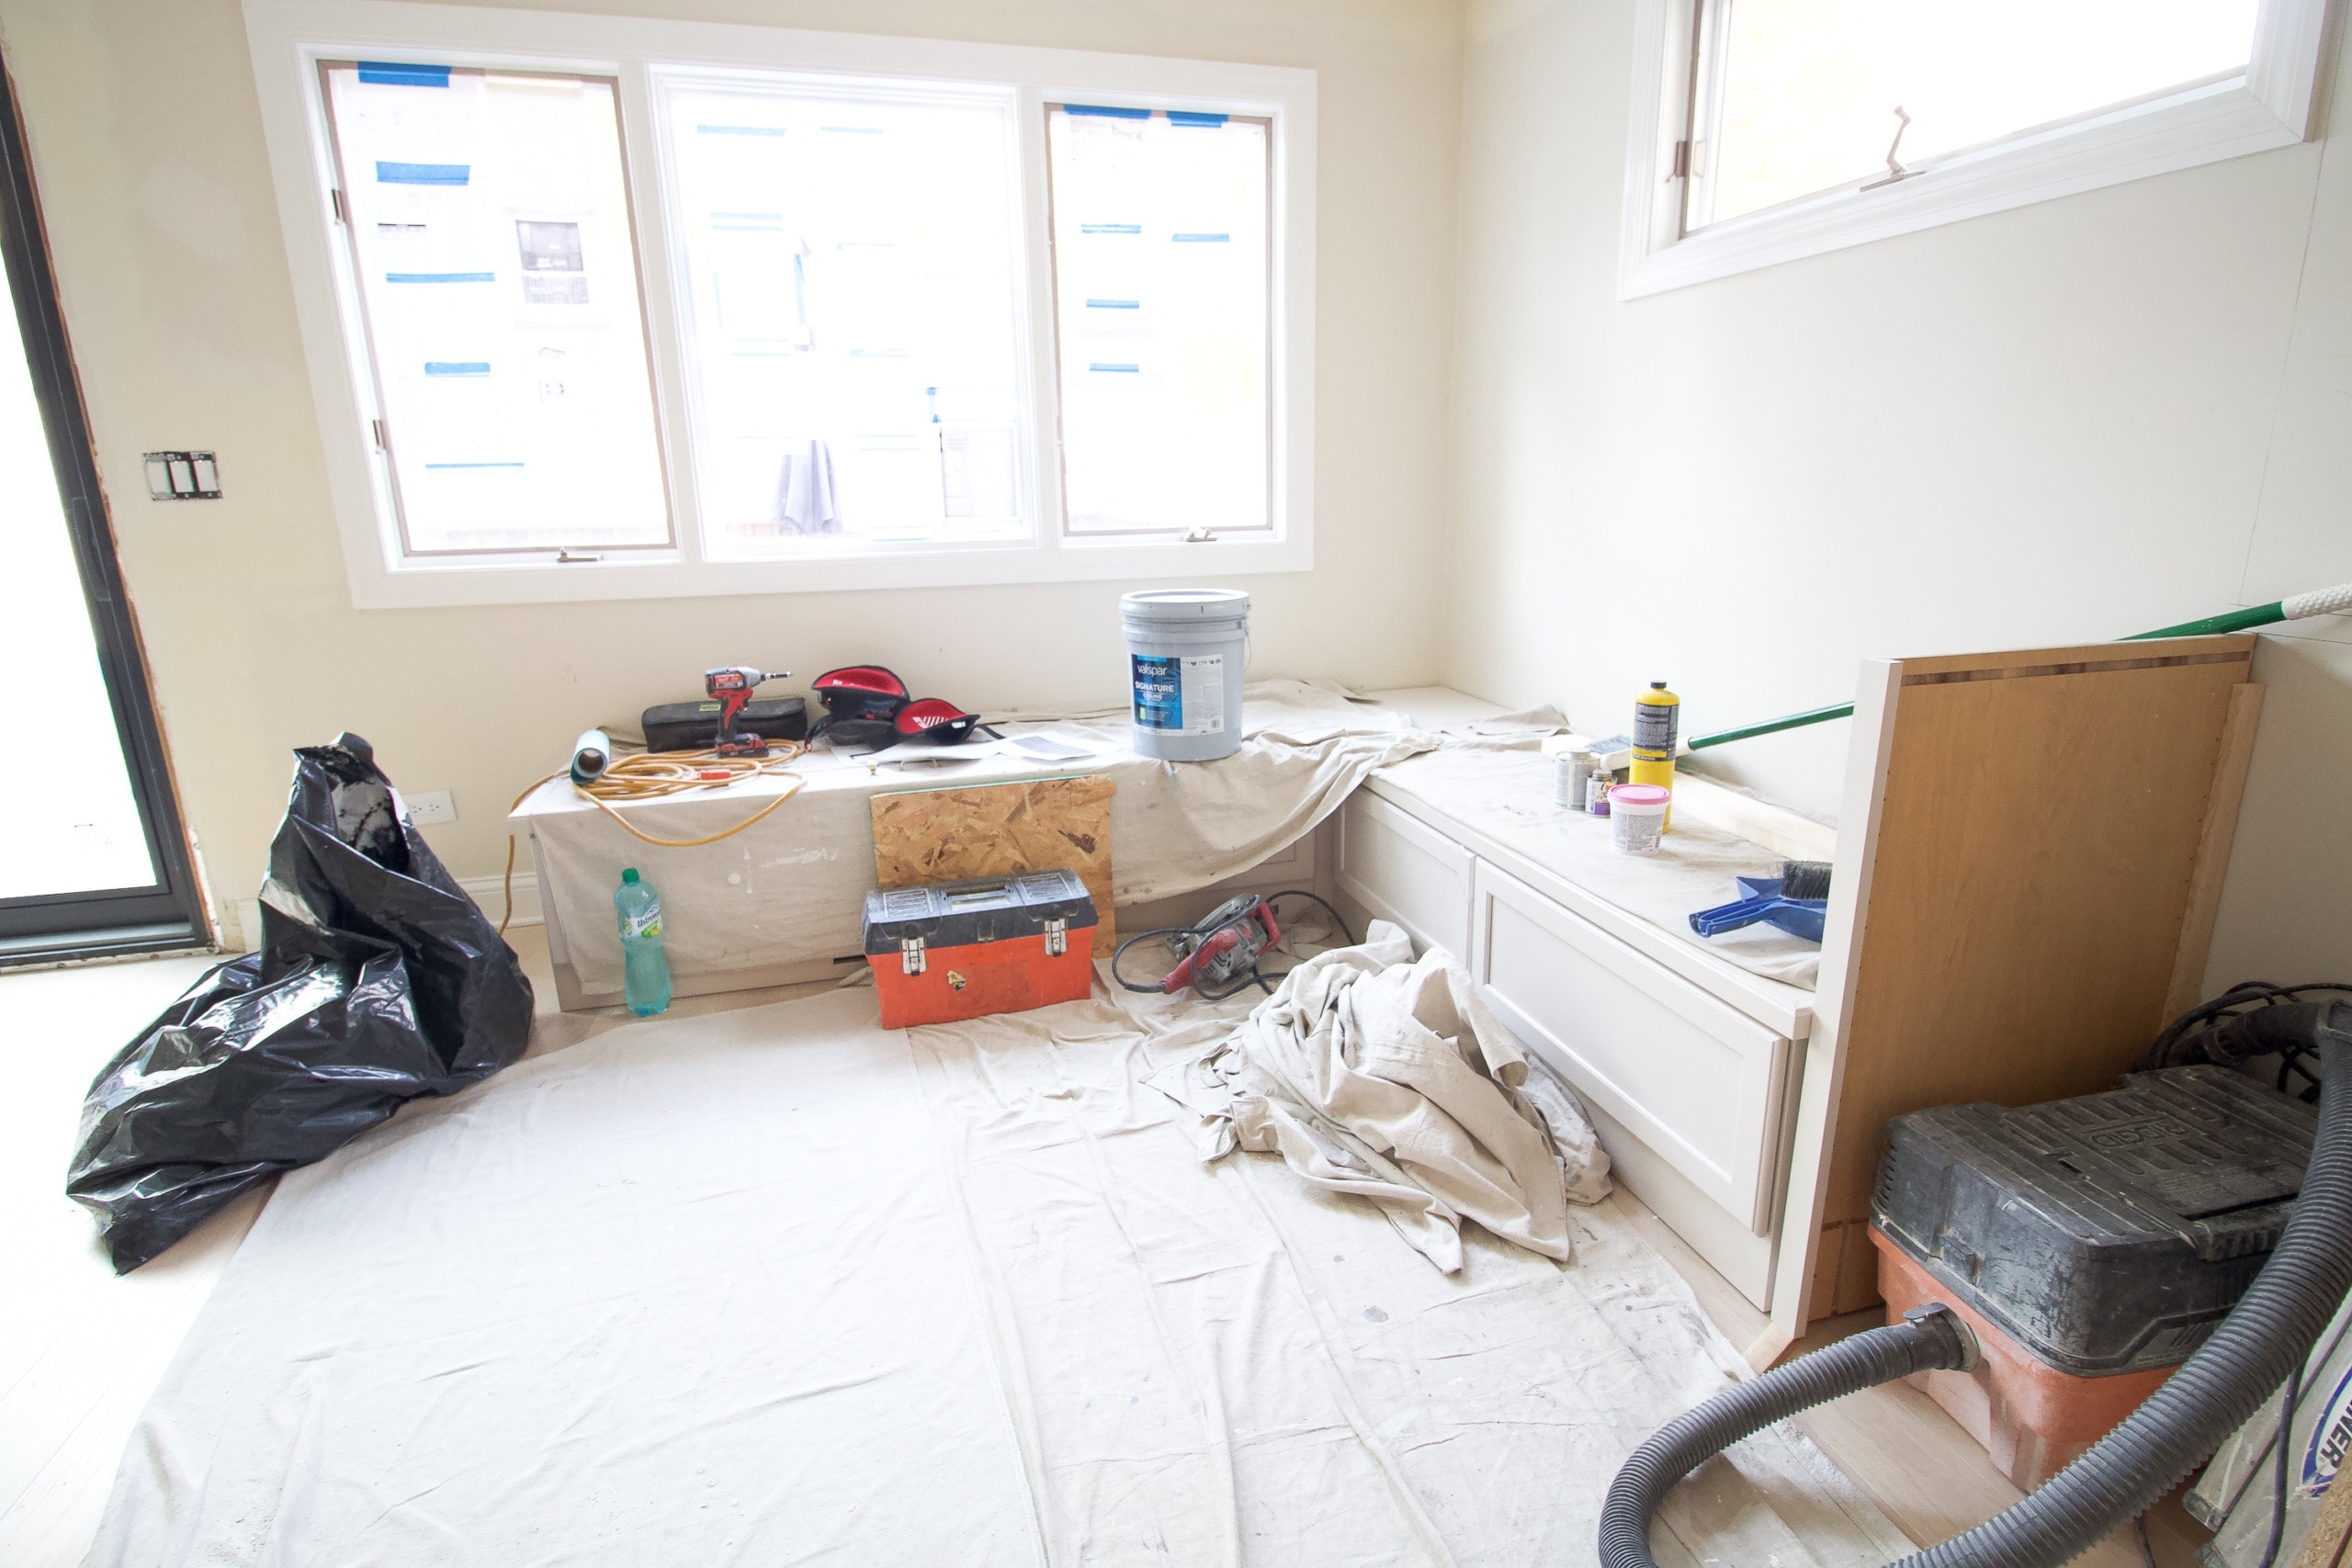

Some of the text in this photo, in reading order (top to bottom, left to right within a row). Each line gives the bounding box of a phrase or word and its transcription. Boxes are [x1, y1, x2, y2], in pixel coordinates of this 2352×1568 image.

[1137, 664, 1167, 677] valspar
[1135, 682, 1174, 693] SIGNATURE
[2320, 1399, 2352, 1468] NER
